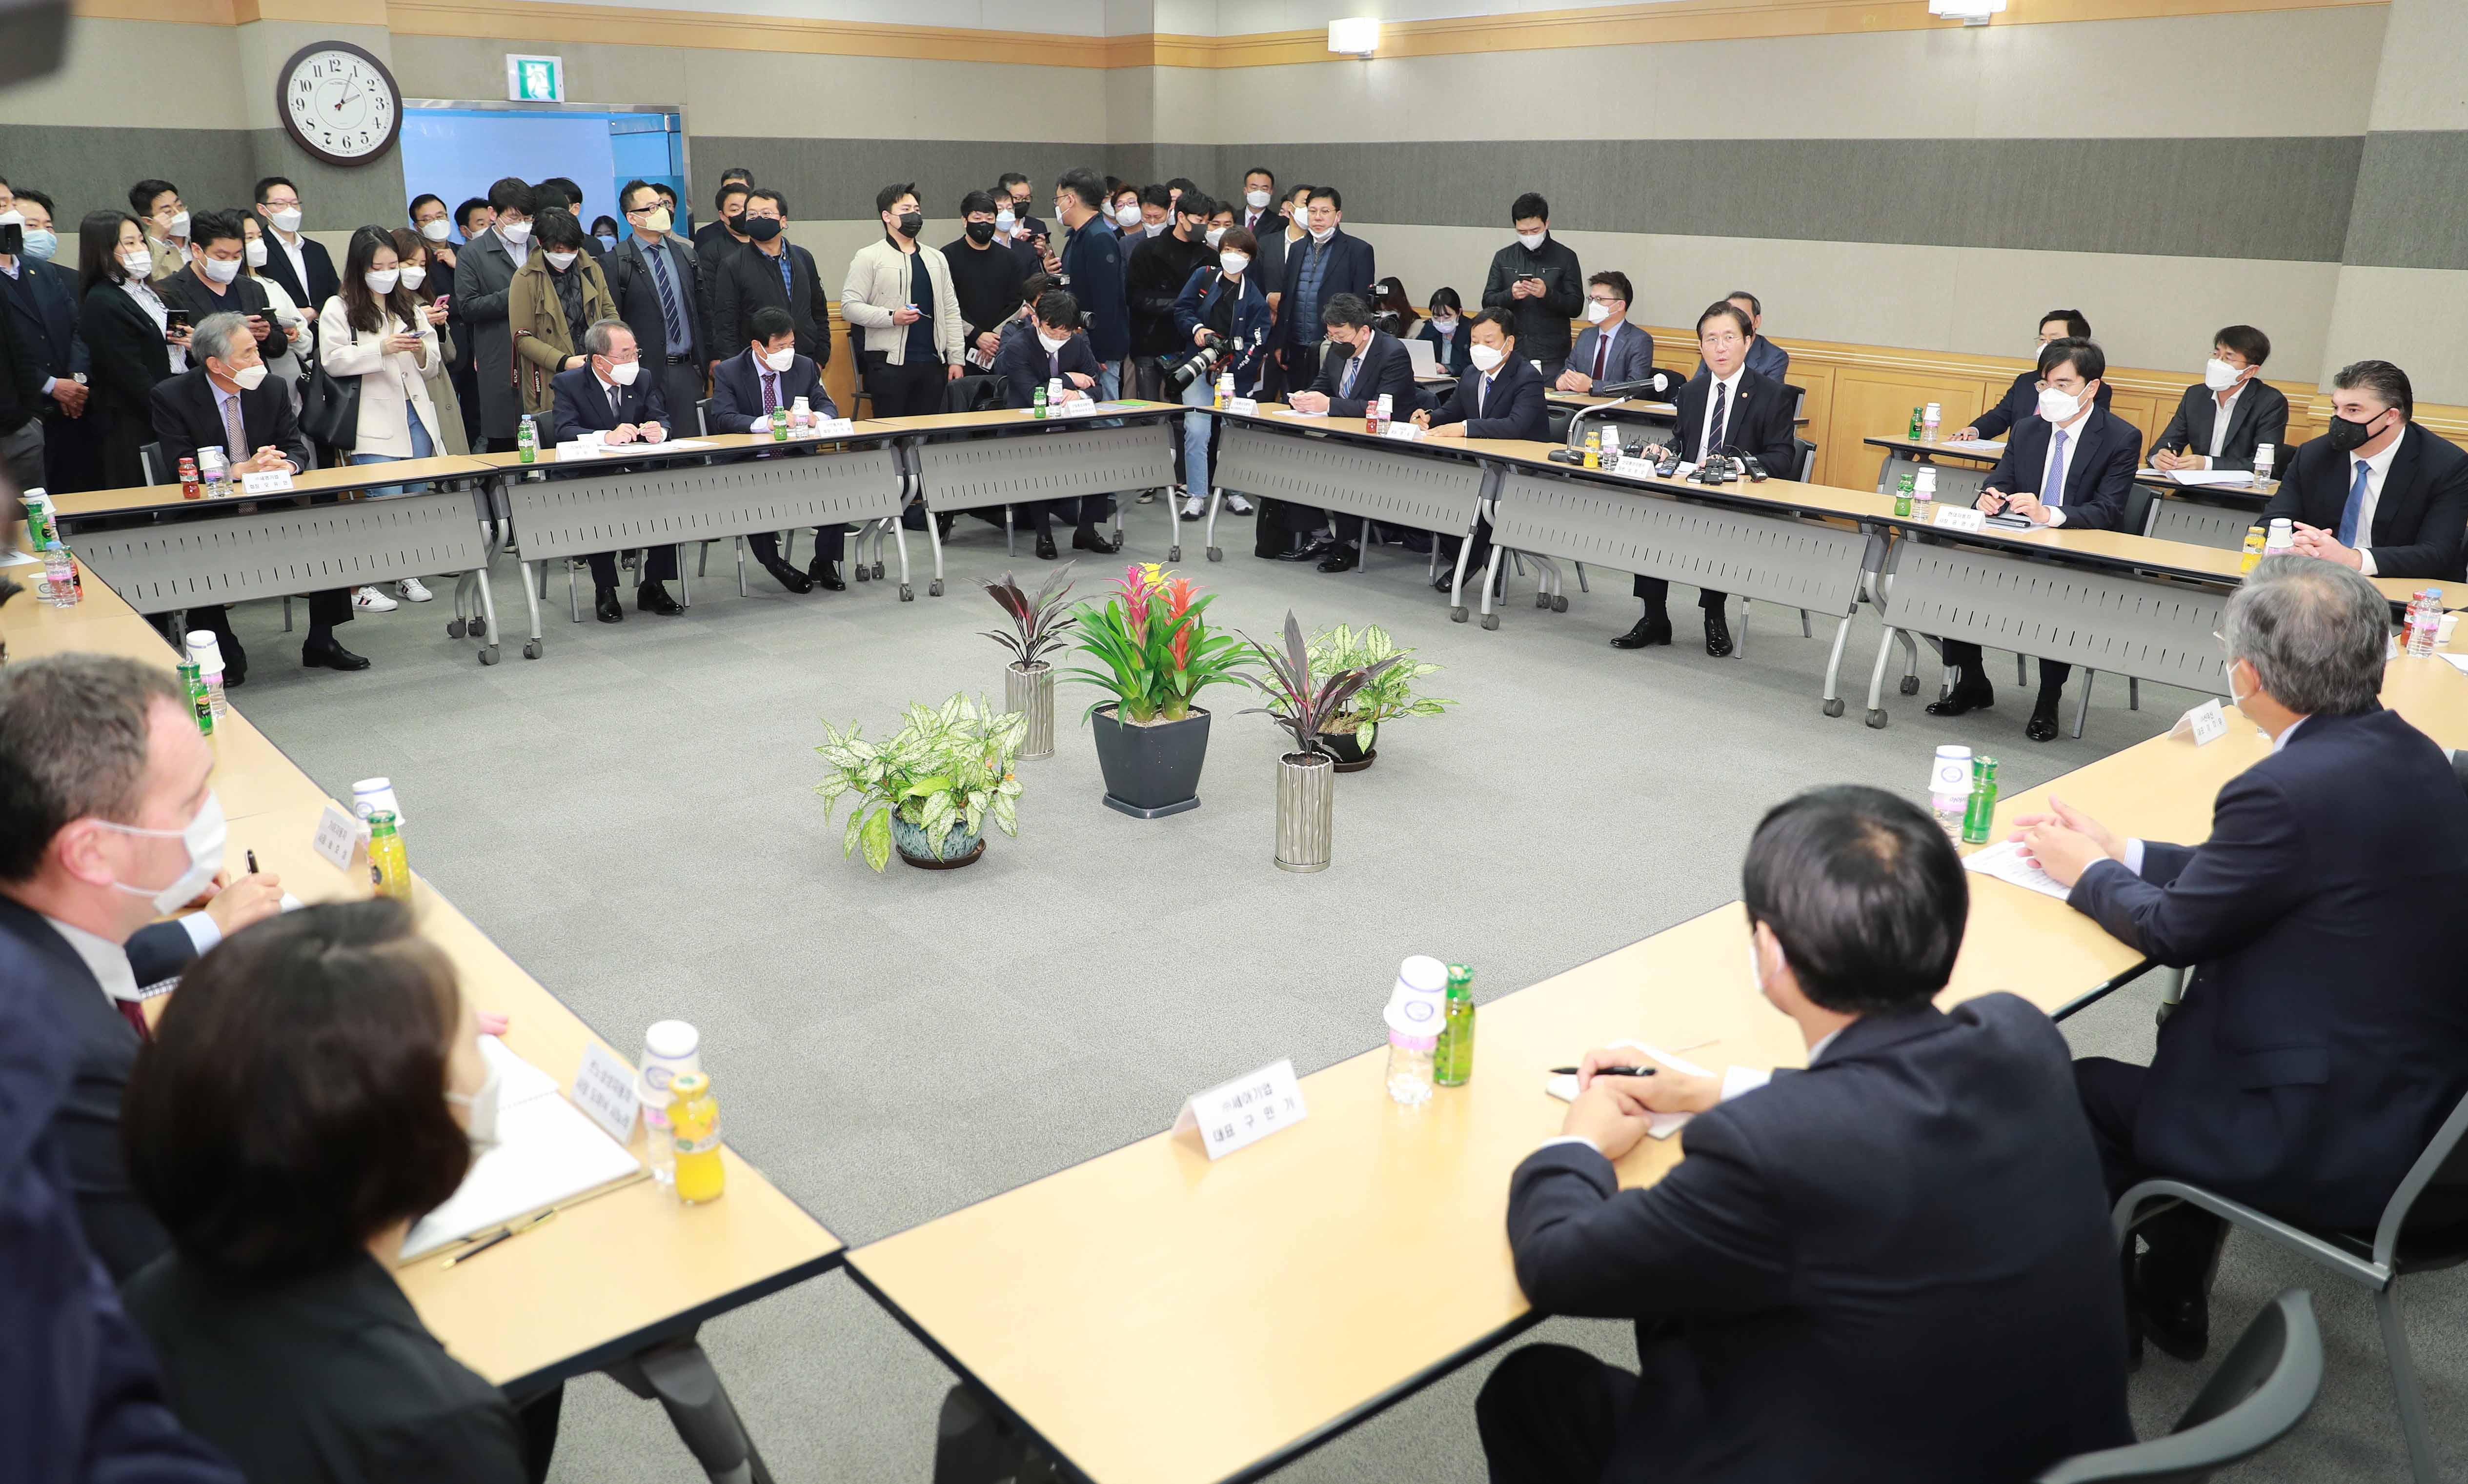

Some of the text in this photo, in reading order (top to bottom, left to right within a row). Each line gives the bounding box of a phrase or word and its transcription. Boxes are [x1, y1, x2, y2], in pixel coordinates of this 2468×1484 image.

[313, 65, 323, 78] 11
[328, 59, 341, 72] 12
[353, 65, 359, 78] 1
[300, 80, 312, 92] 10
[367, 79, 376, 92] 2
[296, 98, 305, 111] 9
[375, 97, 384, 110] 3
[306, 118, 315, 131] 8
[372, 117, 382, 129] 4
[324, 132, 332, 145] 7
[343, 135, 351, 149] 6
[360, 131, 369, 144] 5
